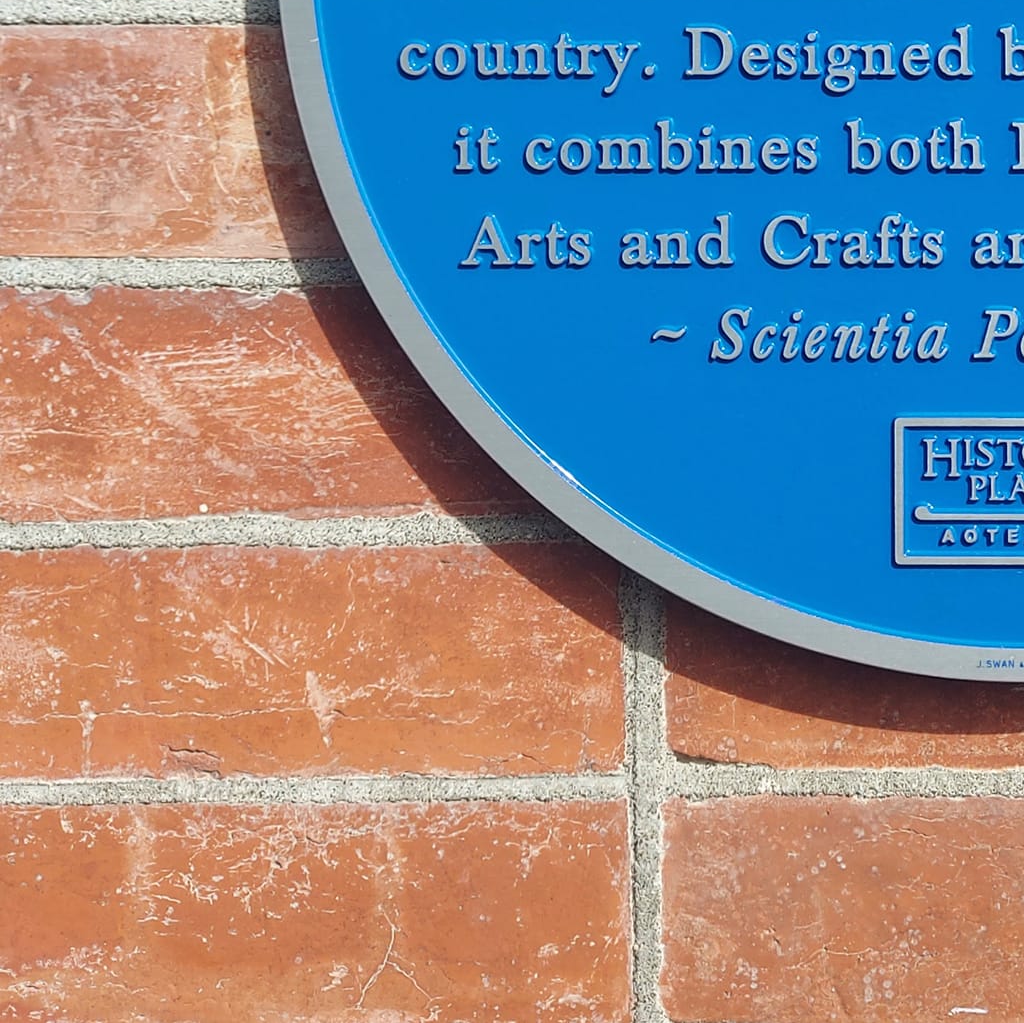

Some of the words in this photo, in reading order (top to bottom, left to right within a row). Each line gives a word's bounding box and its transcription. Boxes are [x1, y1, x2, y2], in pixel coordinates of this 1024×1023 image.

[398, 36, 655, 94] country.
[686, 25, 973, 92] Designed
[455, 126, 498, 172] it
[525, 121, 818, 172] combines
[847, 118, 984, 172] both
[461, 216, 592, 267] Arts
[621, 215, 734, 267] and
[763, 213, 944, 267] Crafts
[710, 307, 948, 362] Scientia
